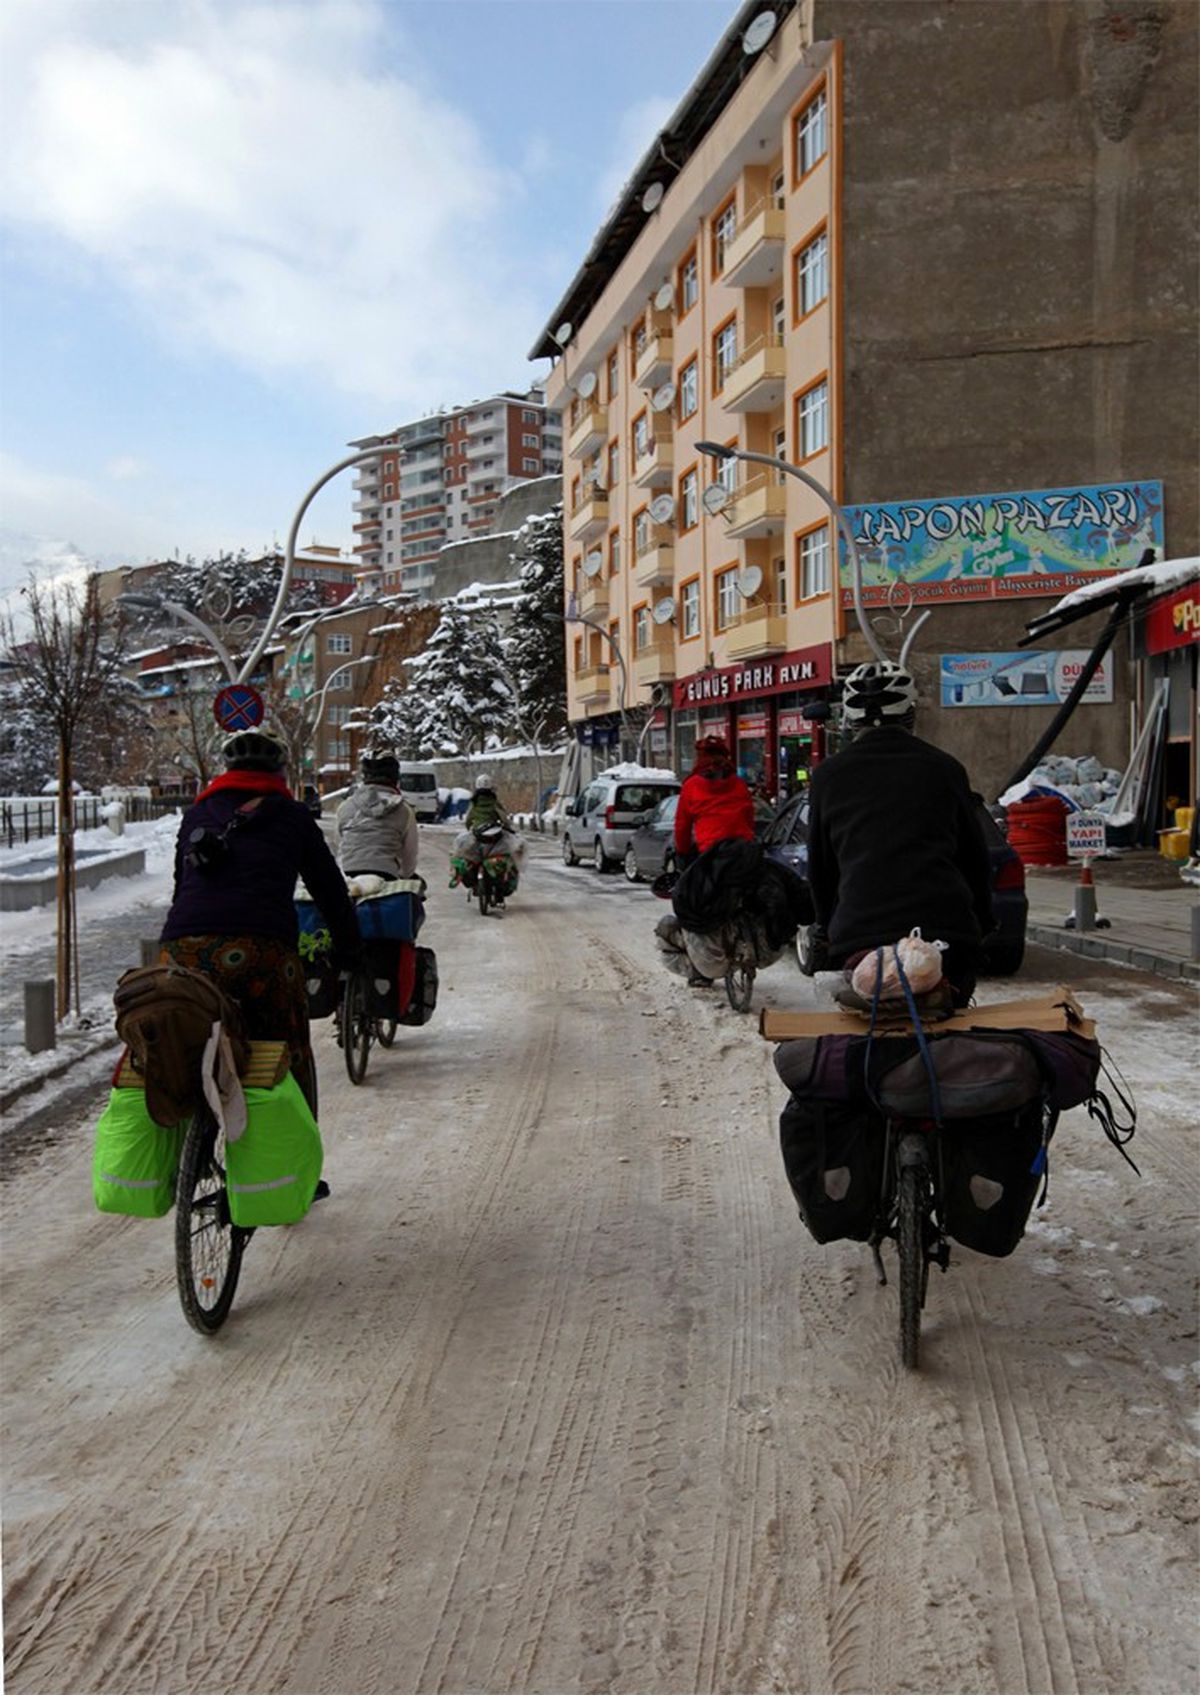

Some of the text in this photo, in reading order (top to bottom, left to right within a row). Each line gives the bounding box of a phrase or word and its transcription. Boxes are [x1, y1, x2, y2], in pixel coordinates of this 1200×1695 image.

[855, 488, 1138, 546] JAPON PAZARI
[687, 673, 729, 701] GÜMÜŞ
[734, 665, 773, 692] PARK
[1069, 839, 1103, 848] MARKET
